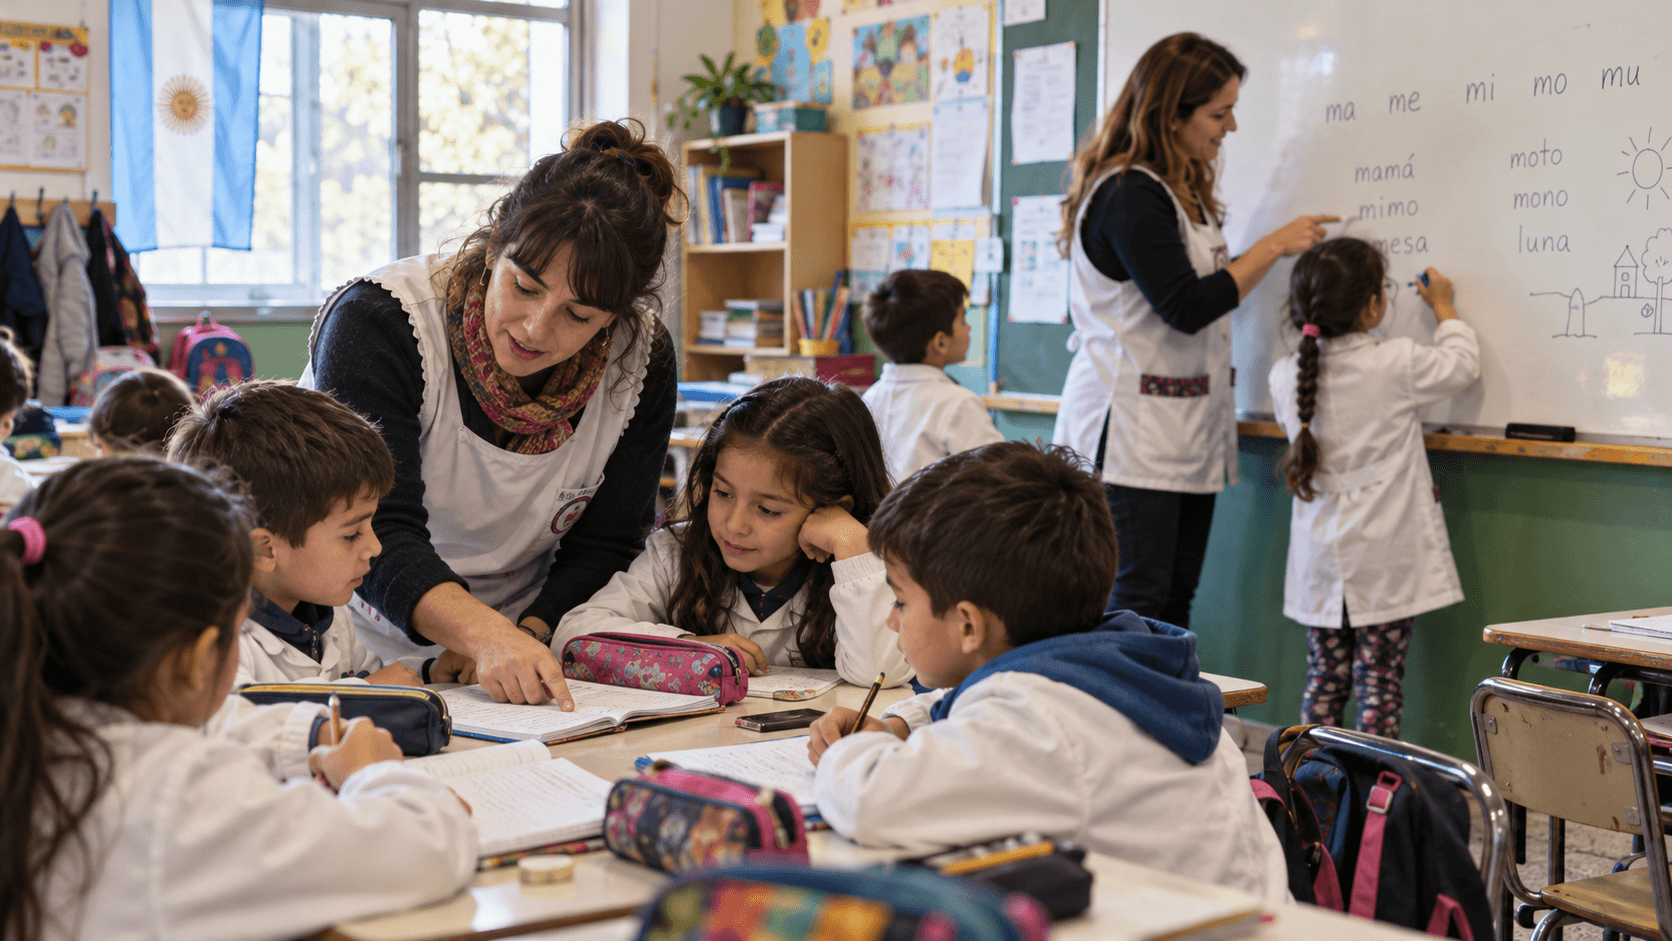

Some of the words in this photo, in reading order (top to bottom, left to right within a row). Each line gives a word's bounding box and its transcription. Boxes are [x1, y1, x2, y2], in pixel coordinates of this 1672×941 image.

[1326, 101, 1356, 123] ma
[1389, 91, 1421, 114] me
[1466, 73, 1495, 104] mi
[1534, 73, 1567, 97] mo
[1602, 65, 1640, 89] mu
[1355, 153, 1415, 183] mamá
[1511, 138, 1562, 169] moto
[1359, 196, 1418, 219] mimo
[1514, 190, 1568, 209] mono
[1519, 225, 1570, 253] luna
